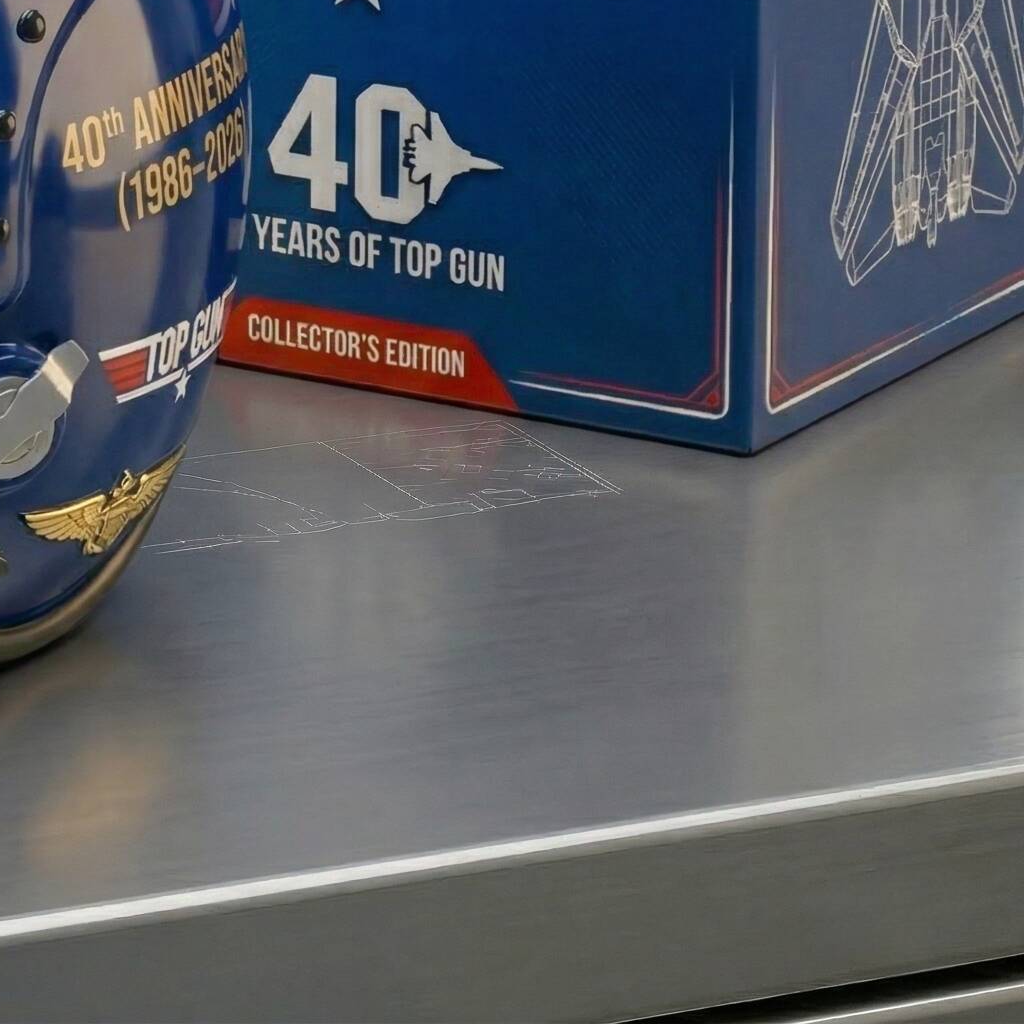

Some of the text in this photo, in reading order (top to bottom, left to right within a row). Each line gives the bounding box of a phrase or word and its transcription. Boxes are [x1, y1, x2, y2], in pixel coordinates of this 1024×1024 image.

[62, 106, 125, 173] 40th
[267, 73, 427, 225] 40
[251, 213, 505, 292] YEARS OF TOP GUN
[145, 295, 227, 382] TOP GUN
[248, 313, 465, 378] COLLECTOR'S EDITION
